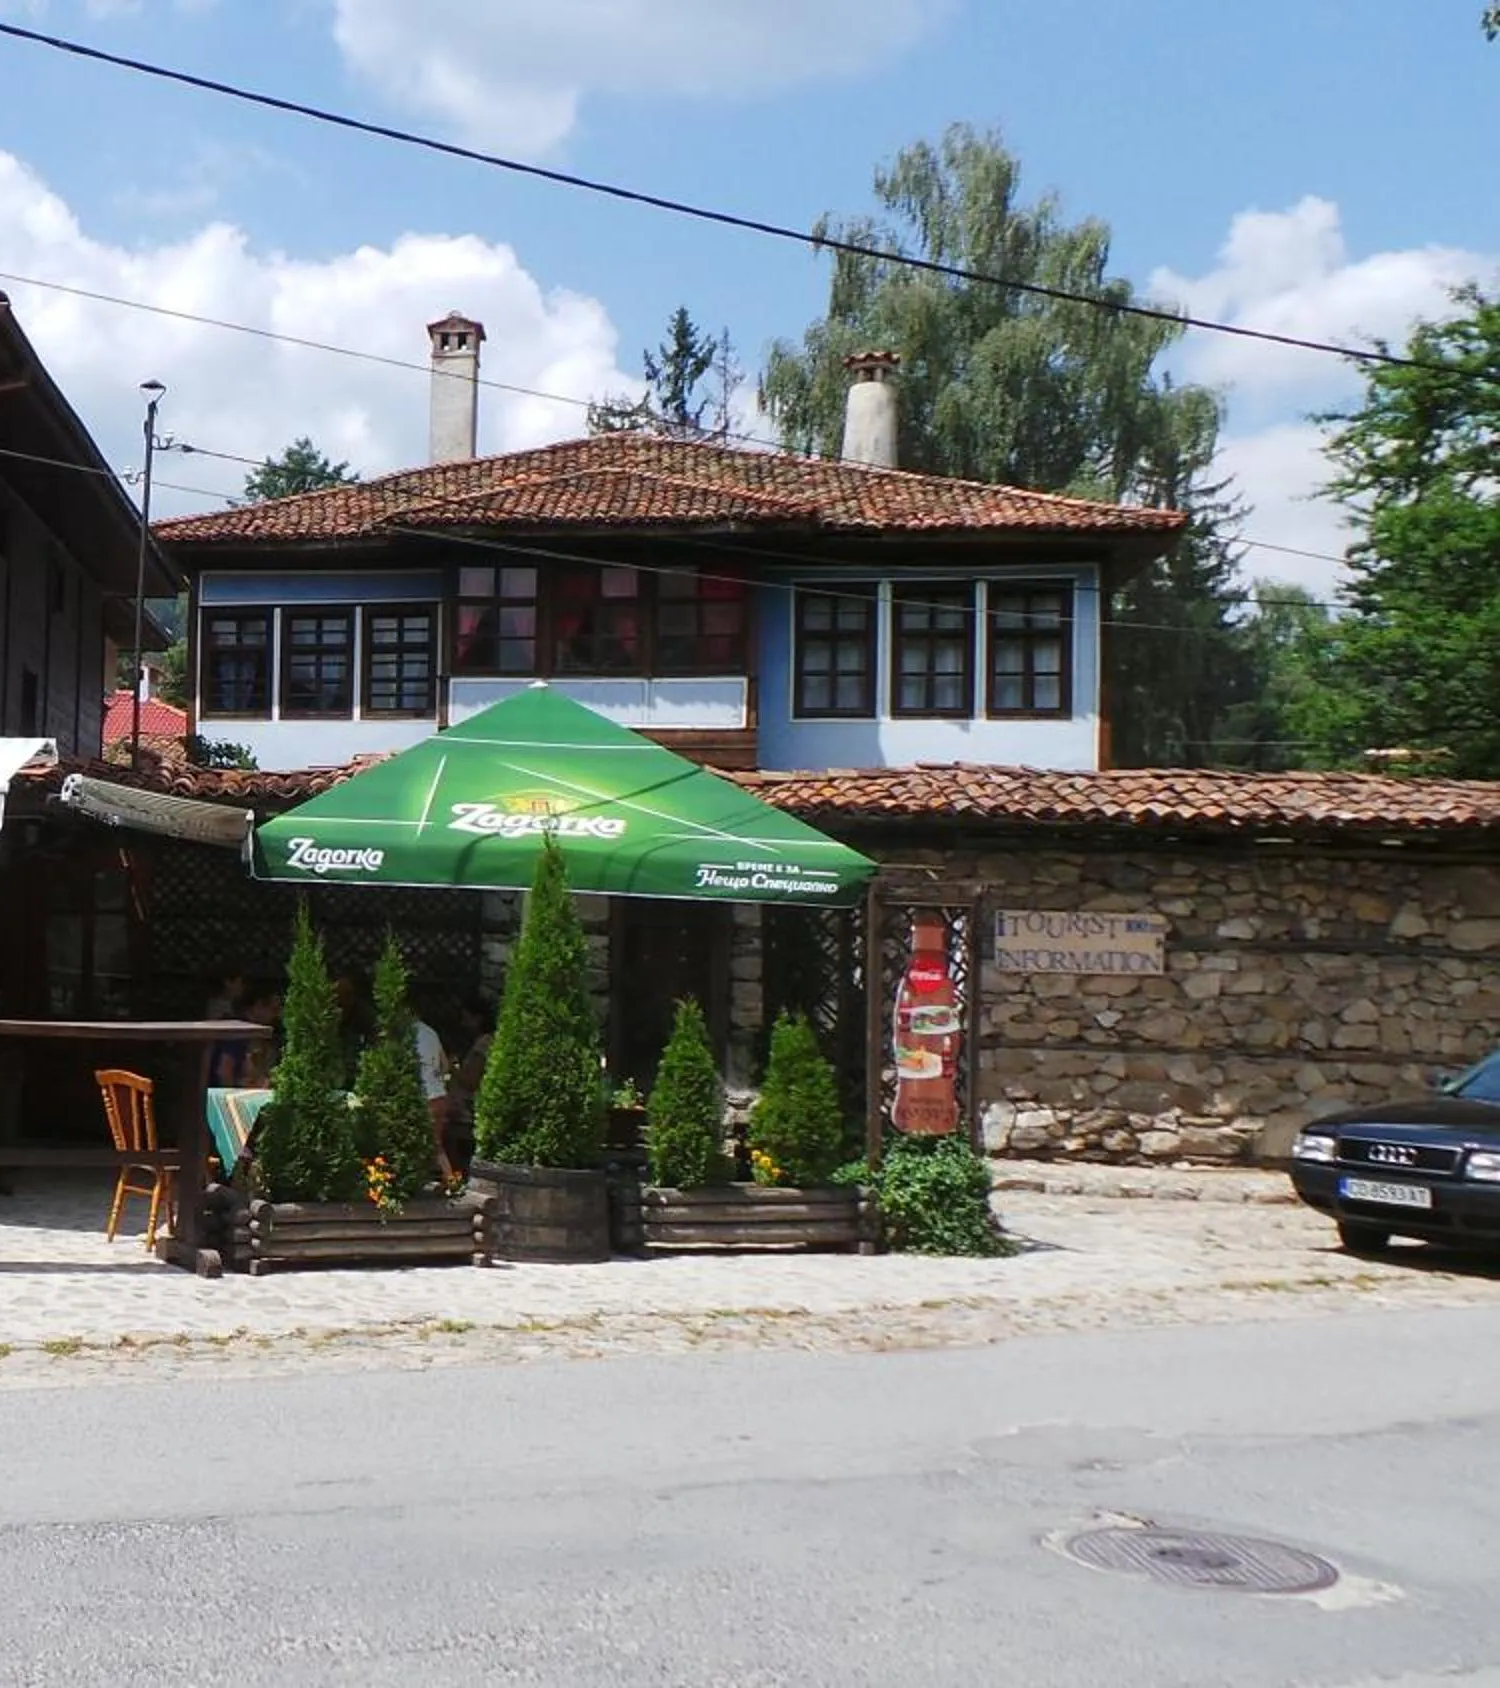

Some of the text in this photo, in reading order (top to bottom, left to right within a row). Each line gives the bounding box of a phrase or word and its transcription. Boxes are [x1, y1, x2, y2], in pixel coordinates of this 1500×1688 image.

[446, 802, 627, 838] Zagorka
[286, 837, 384, 872] Zagorka
[1007, 911, 1121, 938] TOURIST
[997, 948, 1160, 971] INFORMATION
